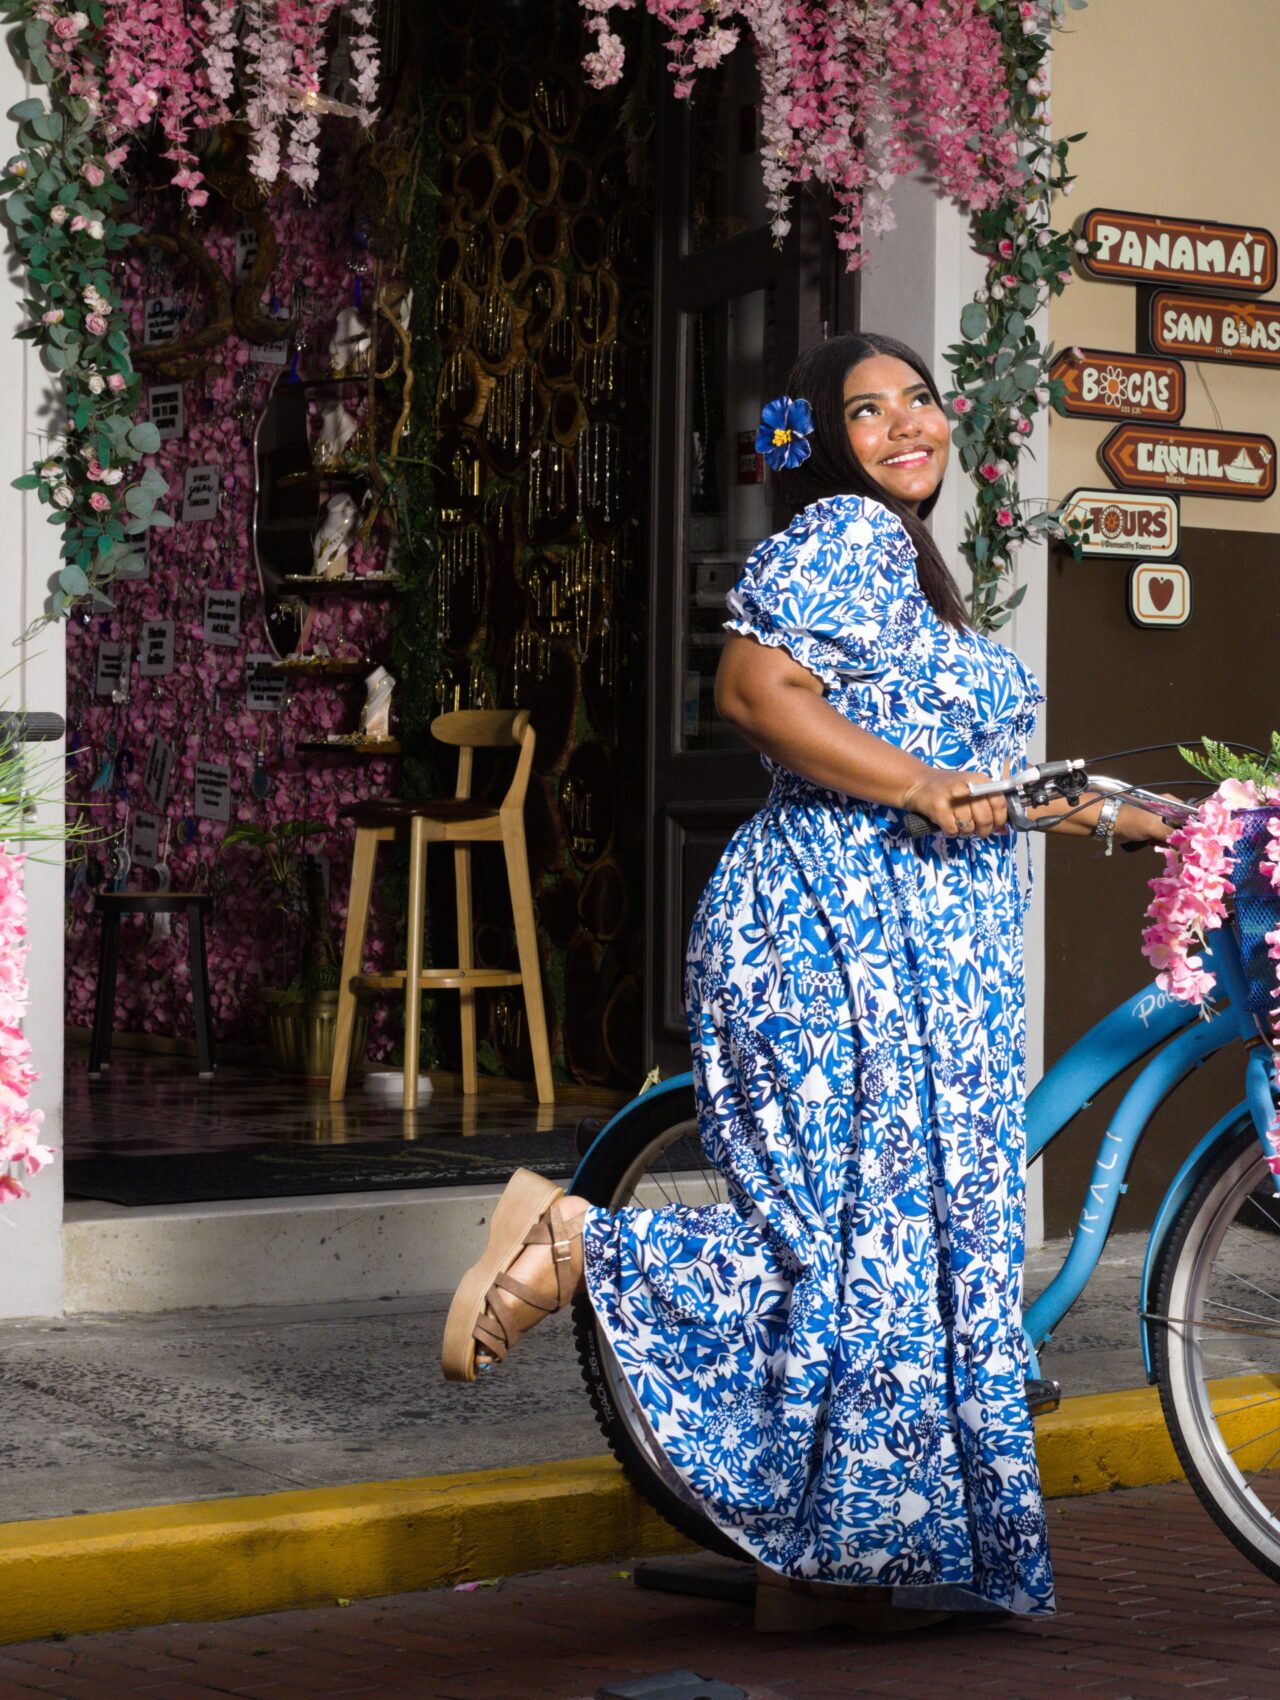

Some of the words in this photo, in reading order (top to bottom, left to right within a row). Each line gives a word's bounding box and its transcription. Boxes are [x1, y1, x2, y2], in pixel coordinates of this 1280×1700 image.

[1097, 224, 1265, 285] PANAMÁ!
[1163, 310, 1213, 344] SAN
[1082, 365, 1169, 411] BOCAS
[1137, 441, 1225, 478] CANAL
[1090, 504, 1167, 539] TOURS
